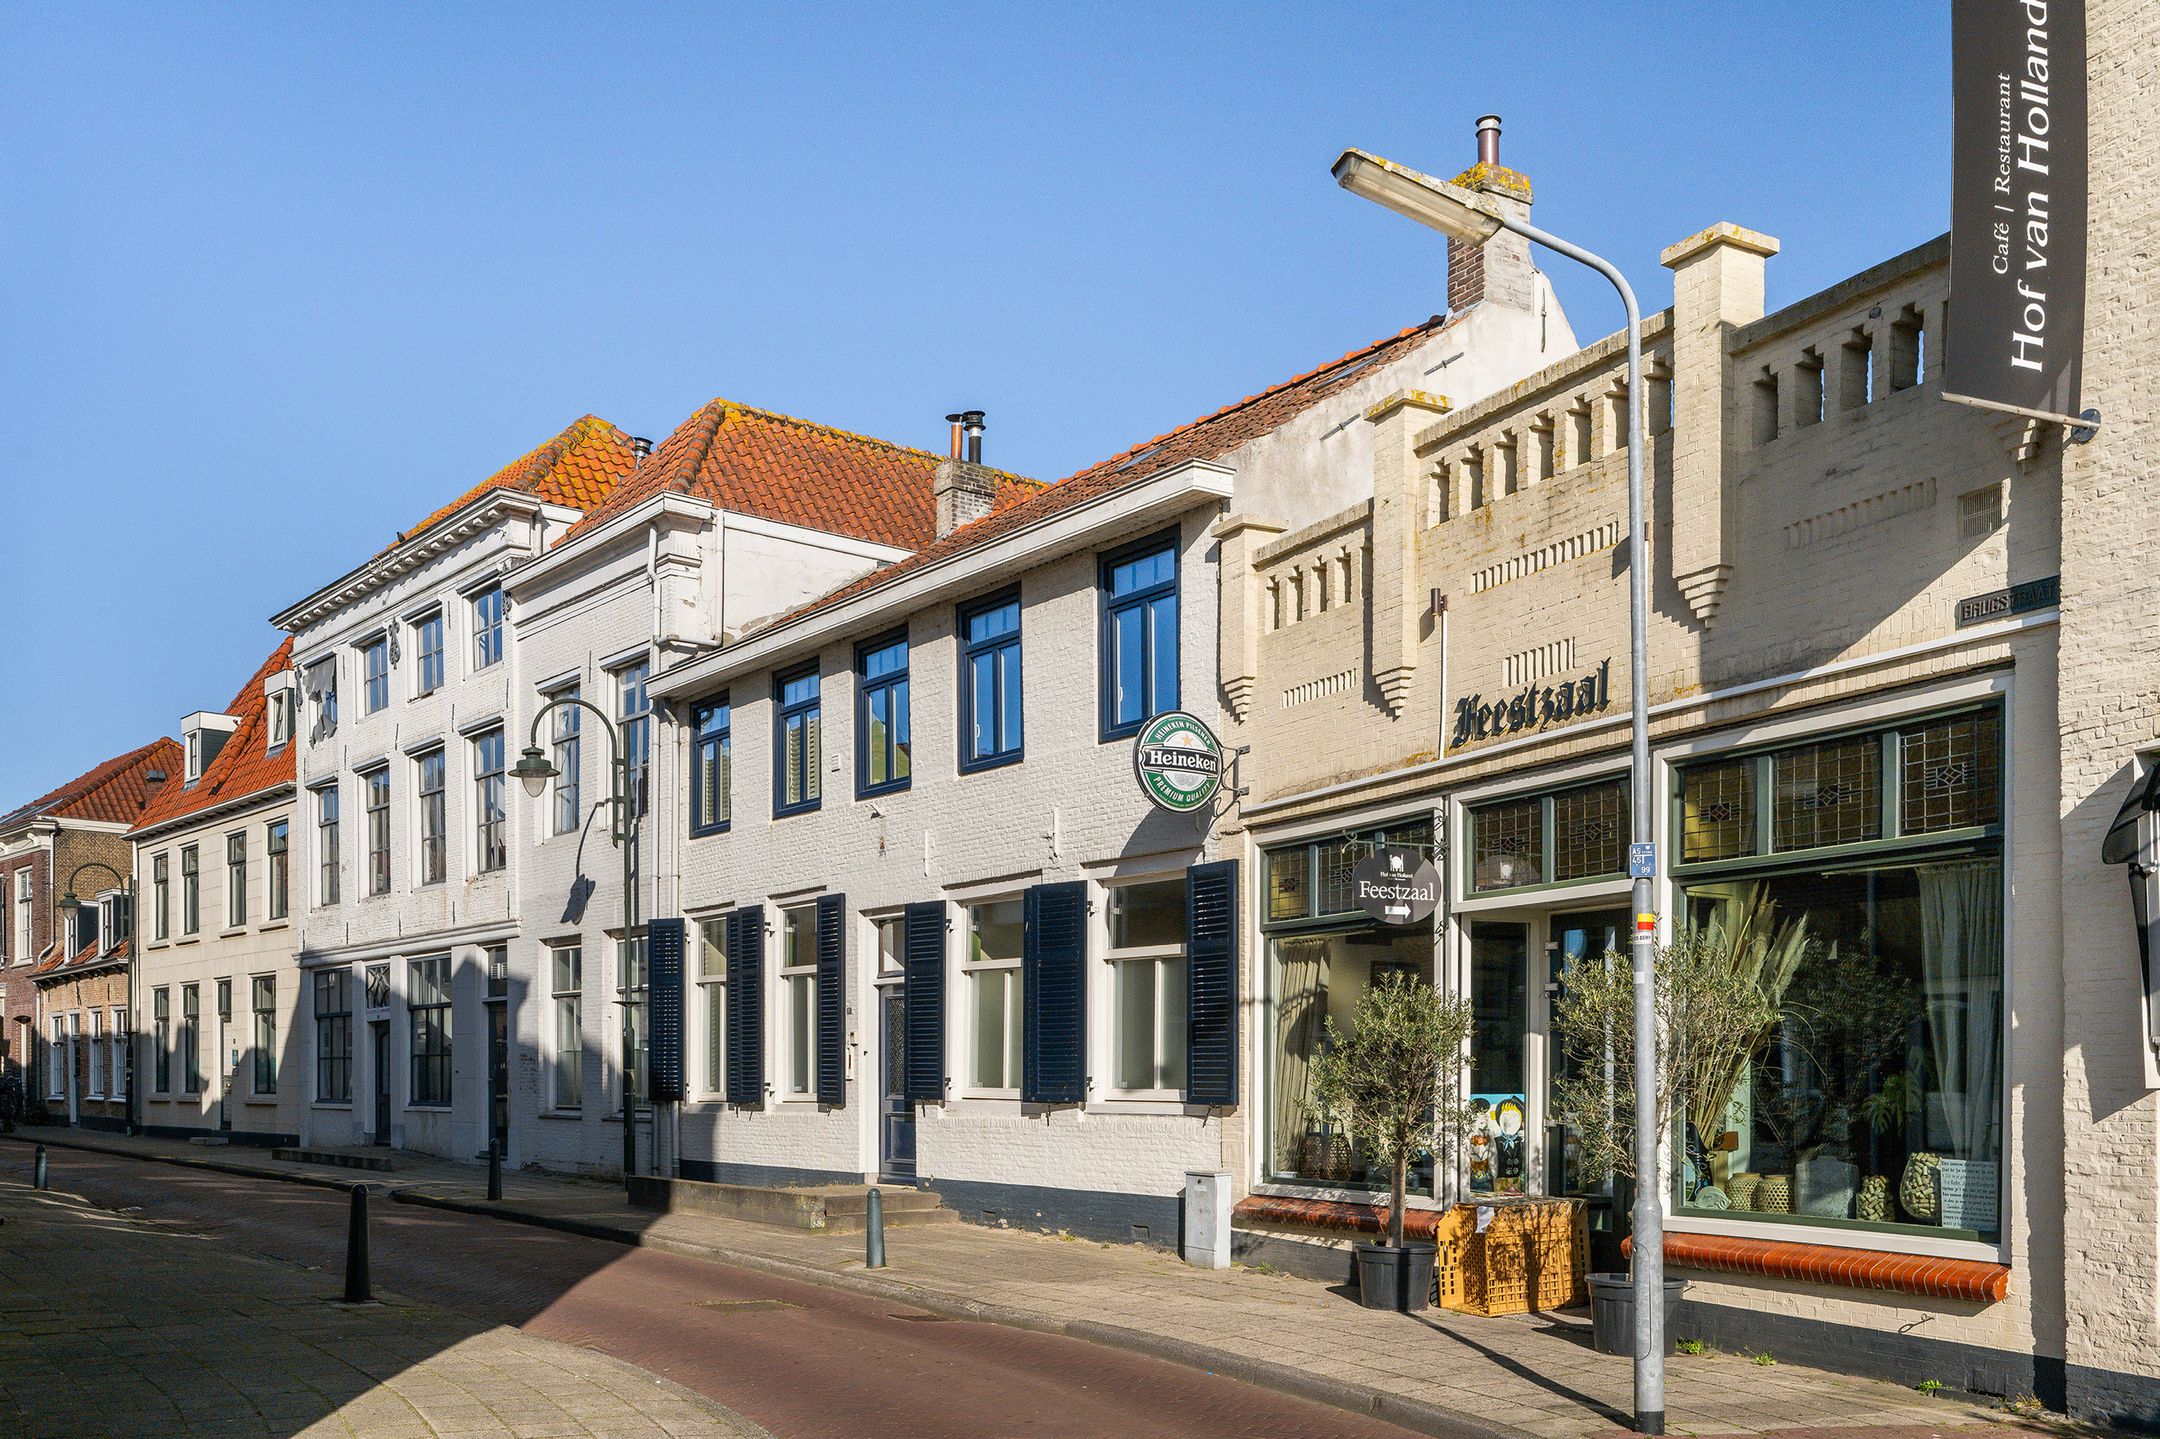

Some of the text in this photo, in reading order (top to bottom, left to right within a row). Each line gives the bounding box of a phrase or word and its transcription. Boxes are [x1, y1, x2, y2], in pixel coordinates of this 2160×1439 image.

[1994, 72, 2011, 196] Restaurant
[2011, 0, 2050, 373] Hof van Holland
[1992, 222, 2009, 275] Café
[1449, 656, 1612, 751] Feestzaal
[1154, 720, 1185, 741] HEINEKEN
[1149, 750, 1218, 772] Heineken
[1153, 775, 1185, 802] PREMIUM
[1186, 782, 1213, 803] QUALITY
[1359, 880, 1435, 901] Feestzaal
